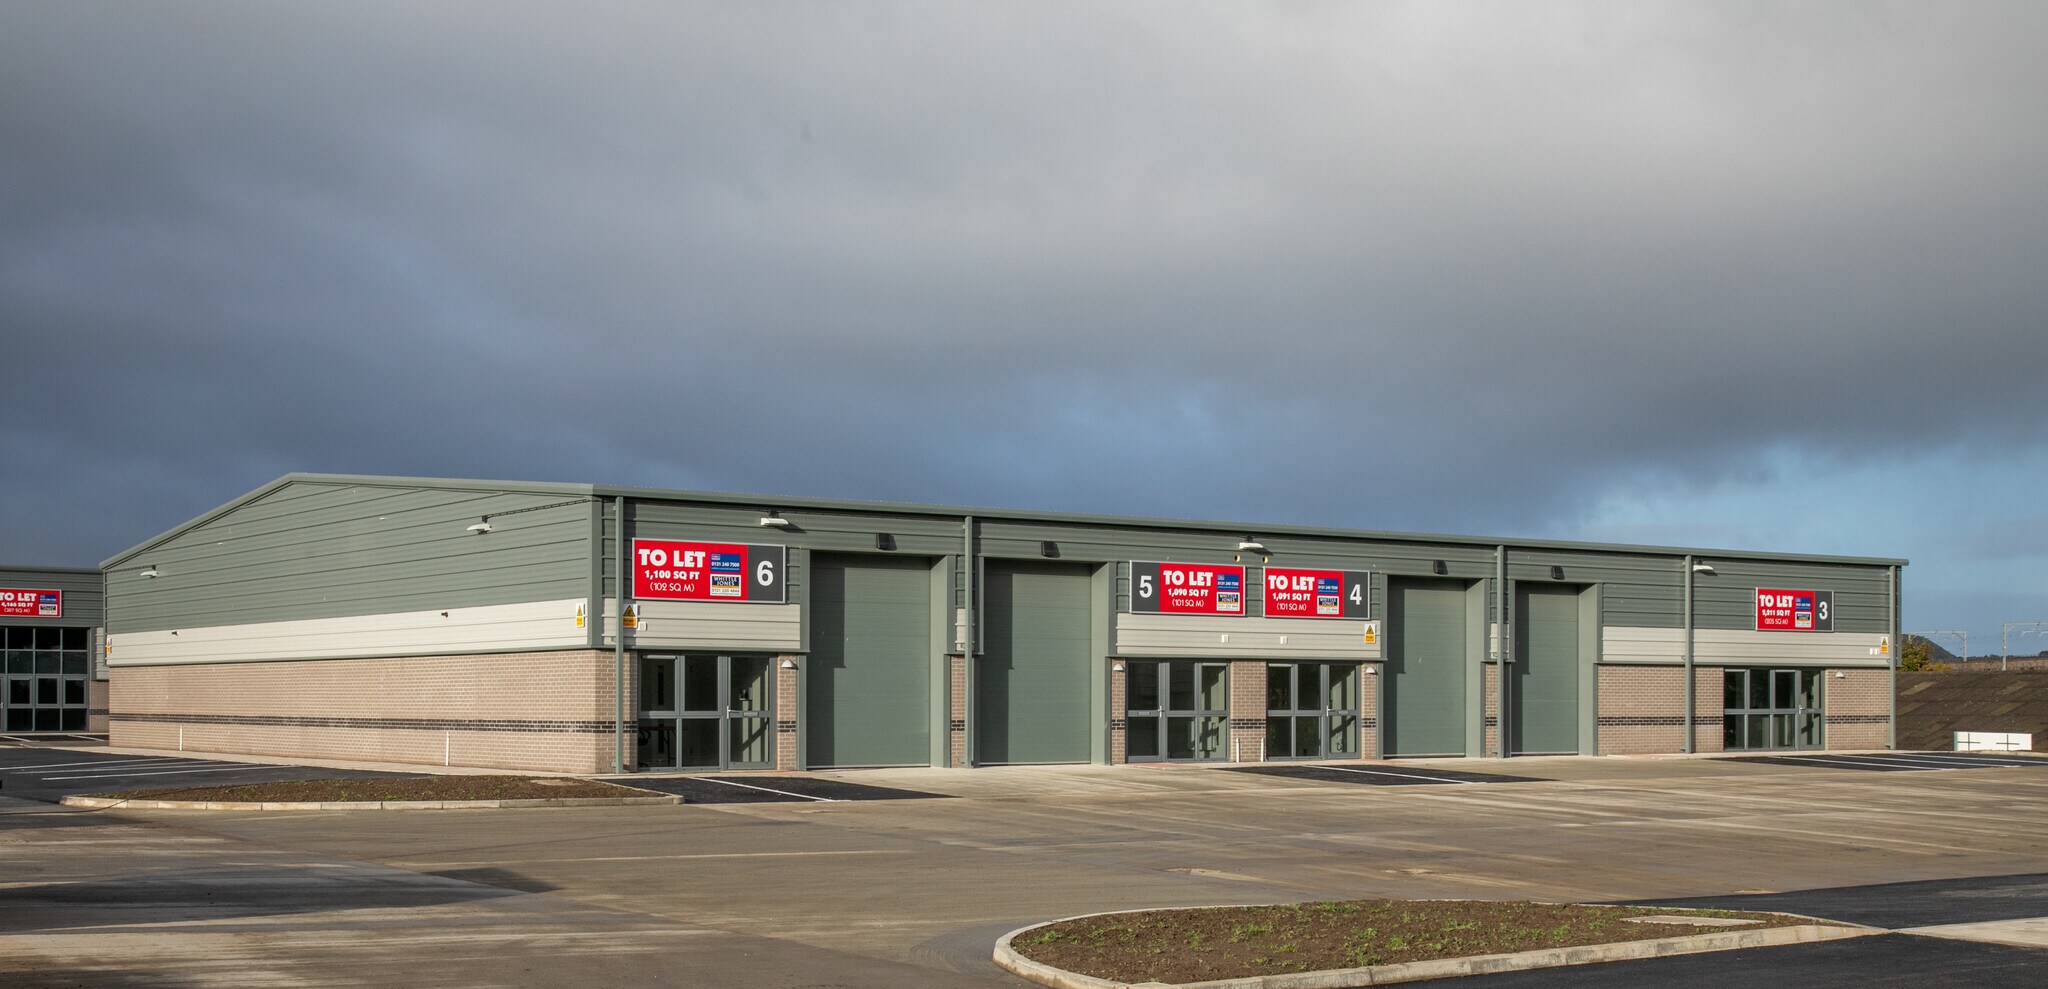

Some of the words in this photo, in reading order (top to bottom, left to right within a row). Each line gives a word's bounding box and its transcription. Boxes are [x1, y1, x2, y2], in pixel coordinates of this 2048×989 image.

[638, 548, 667, 567] TO
[673, 550, 706, 568] LET
[644, 570, 671, 580] 1,100
[673, 571, 687, 580] SQ
[689, 571, 700, 580] FT
[756, 560, 774, 587] 6
[1163, 570, 1185, 585] TO
[1189, 571, 1213, 587] LET
[649, 582, 667, 592] (102
[668, 583, 682, 592] SQ
[683, 583, 695, 592] M)
[1139, 575, 1153, 598] 5
[1268, 575, 1288, 590] TO
[1292, 576, 1315, 591] LET
[0, 592, 15, 601] TO
[18, 592, 36, 602] LET
[1168, 589, 1187, 597] 1,090
[1188, 589, 1199, 597] SQ
[1272, 593, 1290, 601] 1,091
[1292, 593, 1302, 601] SQ
[1349, 584, 1362, 605] 4
[1172, 599, 1184, 607] (101
[1185, 599, 1195, 607] SQ
[1196, 599, 1205, 607] M)
[1289, 603, 1298, 611] SQ
[1298, 603, 1307, 611] M)
[1759, 594, 1774, 607] TO
[1776, 595, 1794, 608] LET
[1818, 602, 1828, 620] 3
